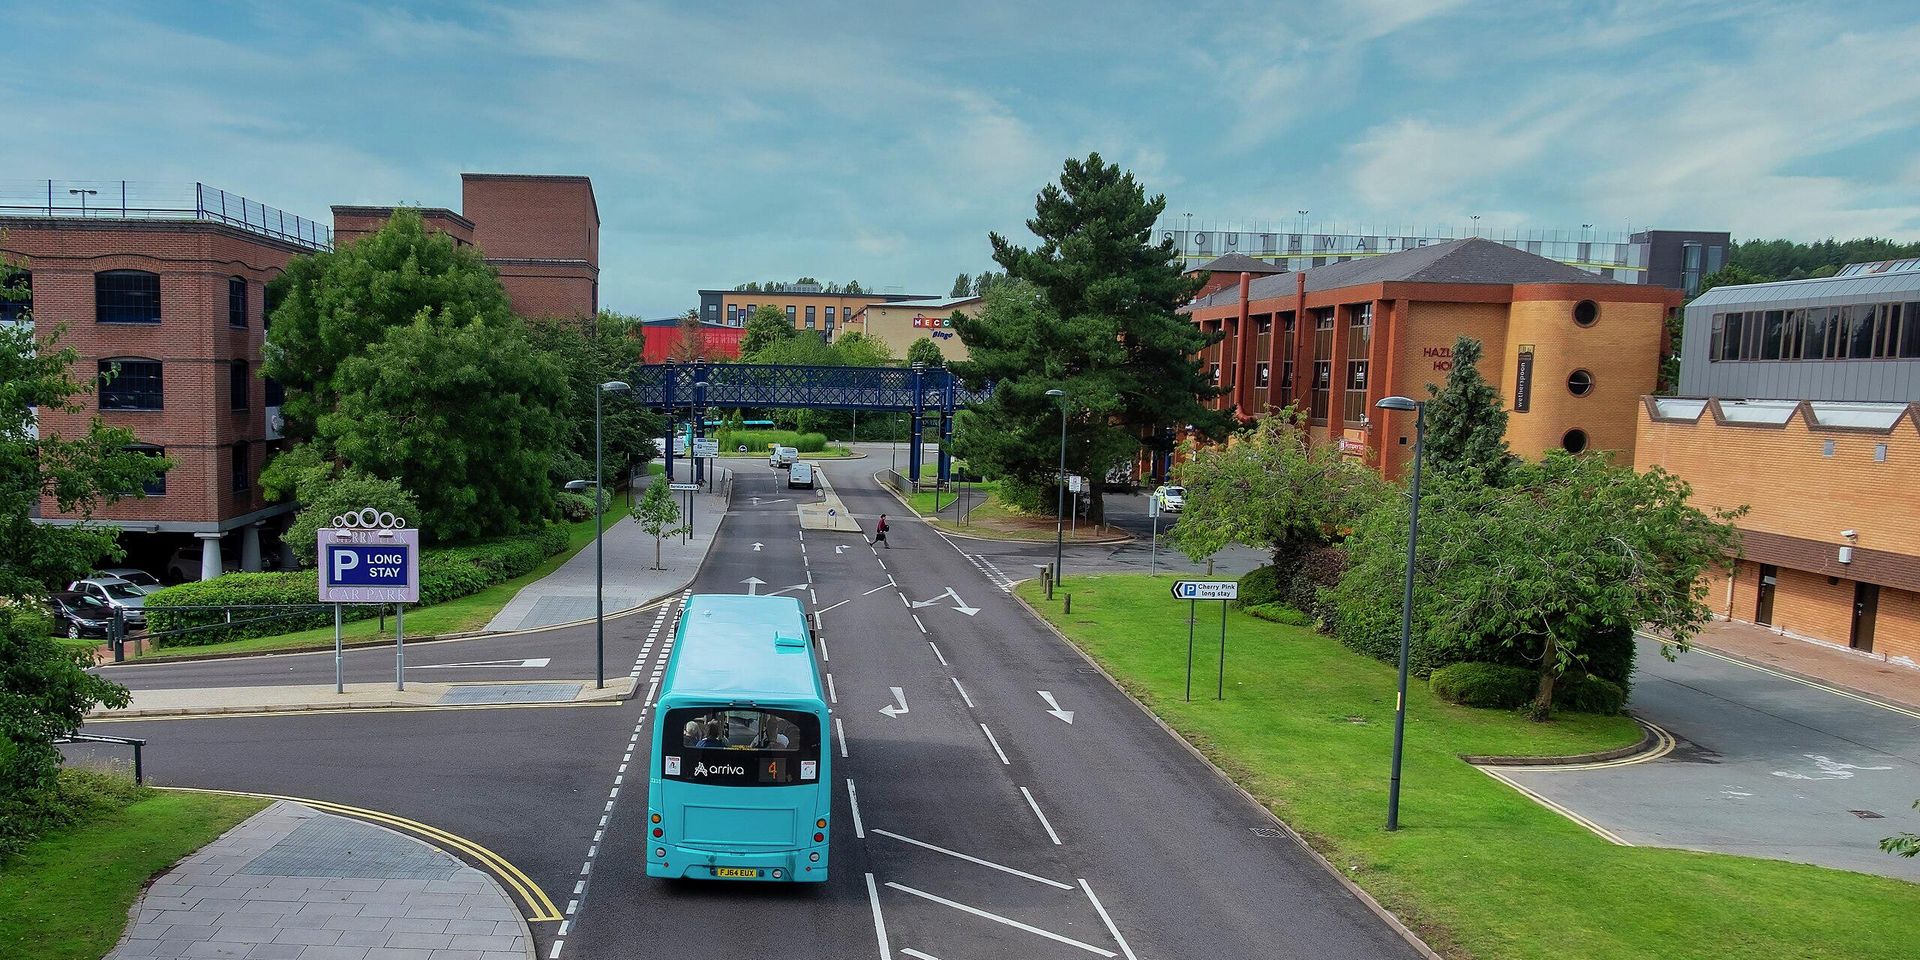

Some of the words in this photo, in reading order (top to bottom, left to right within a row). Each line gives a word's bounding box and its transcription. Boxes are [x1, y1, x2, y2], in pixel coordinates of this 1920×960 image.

[1163, 232, 1426, 250] SOUTHWATE
[914, 319, 950, 327] MECC
[932, 331, 953, 340] Bingo
[1423, 347, 1454, 358] HAZL
[1517, 362, 1526, 408] wetherspoon
[367, 554, 402, 564] LONG
[334, 550, 359, 581] P
[369, 567, 400, 578] STAY
[328, 588, 360, 600] CAR
[366, 588, 407, 600] PARK
[1187, 586, 1195, 595] P
[709, 763, 745, 775] arriva
[768, 761, 778, 779] 4
[740, 869, 754, 877] EUX
